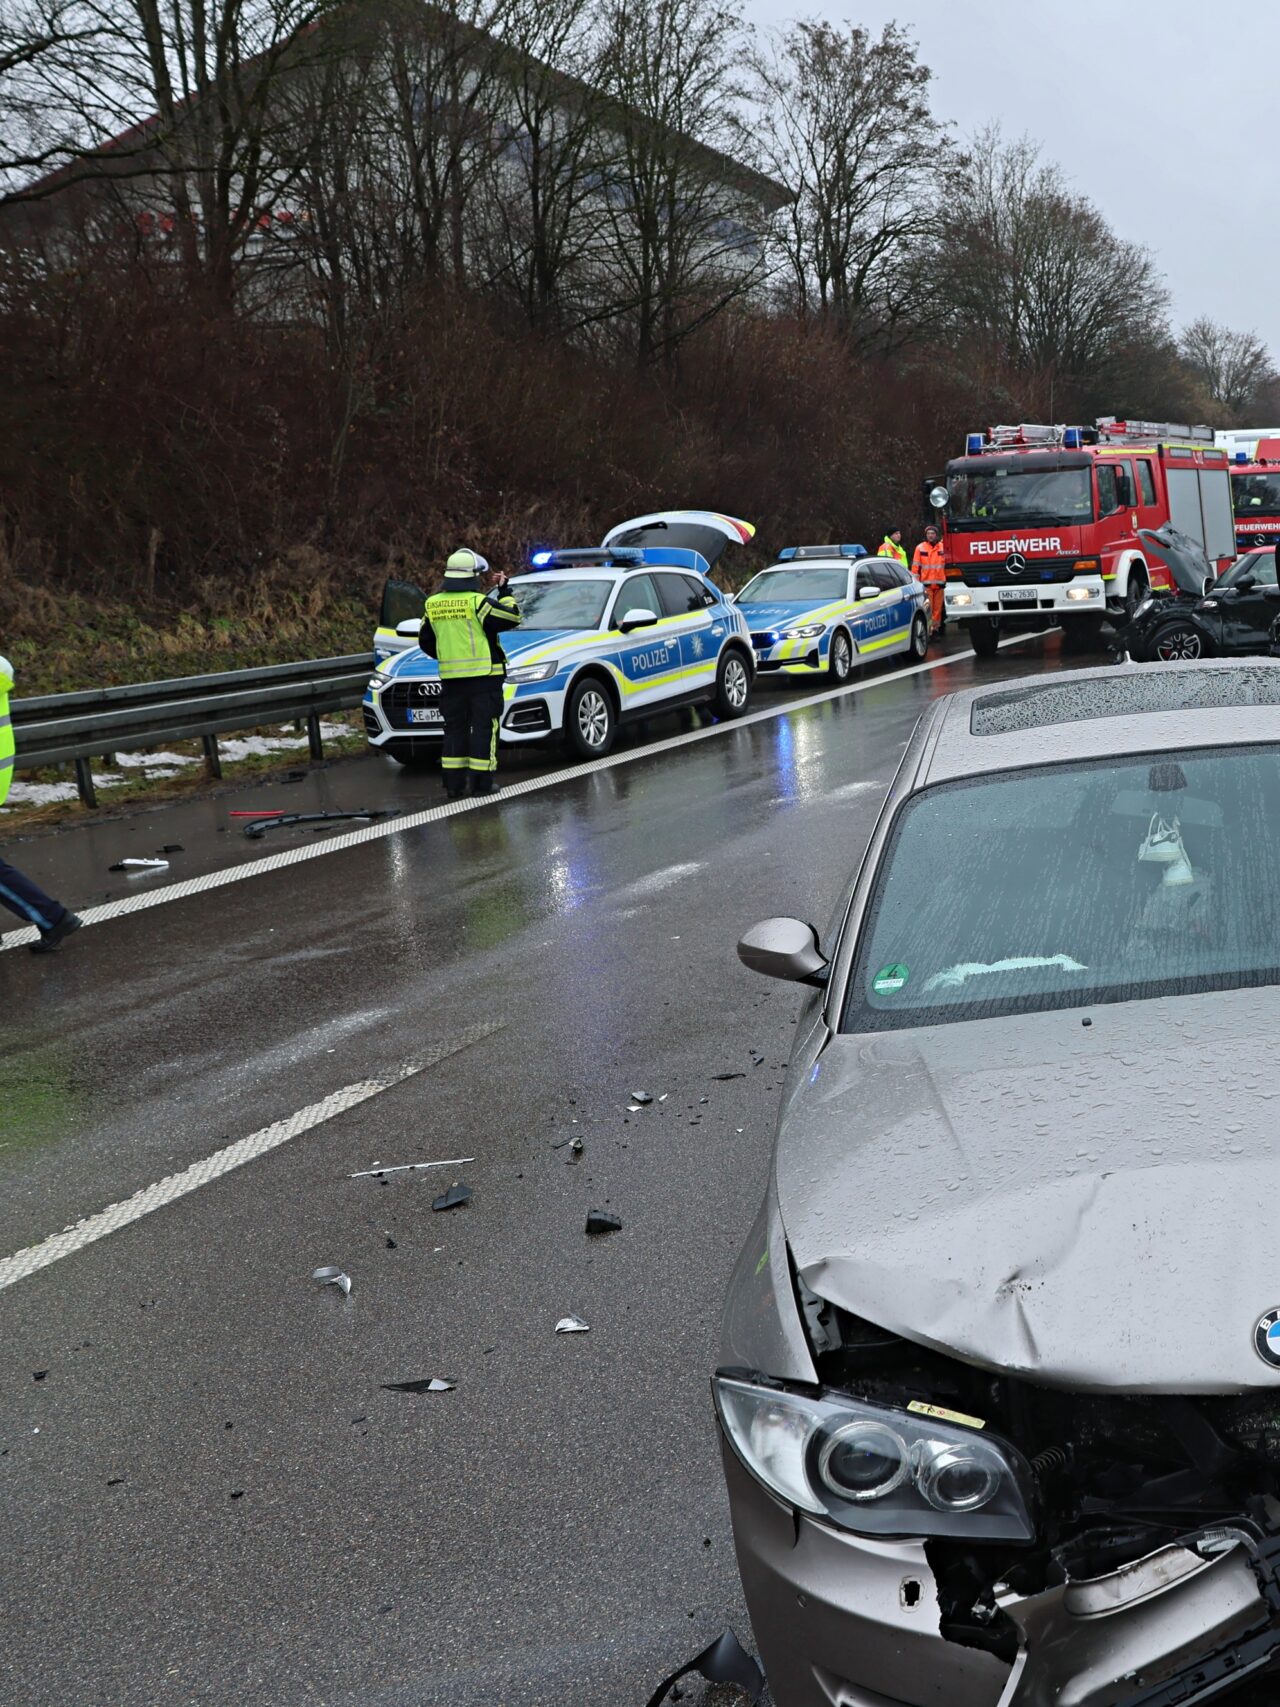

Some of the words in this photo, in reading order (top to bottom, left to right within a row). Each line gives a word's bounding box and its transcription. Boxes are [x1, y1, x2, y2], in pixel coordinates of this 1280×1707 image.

[969, 537, 1060, 555] FEUERWEHR
[427, 600, 468, 609] EINSATZLEITER
[865, 613, 887, 633] POLIZEI
[631, 647, 670, 672] POLIZEI
[412, 710, 424, 721] KE
[887, 964, 899, 979] 4
